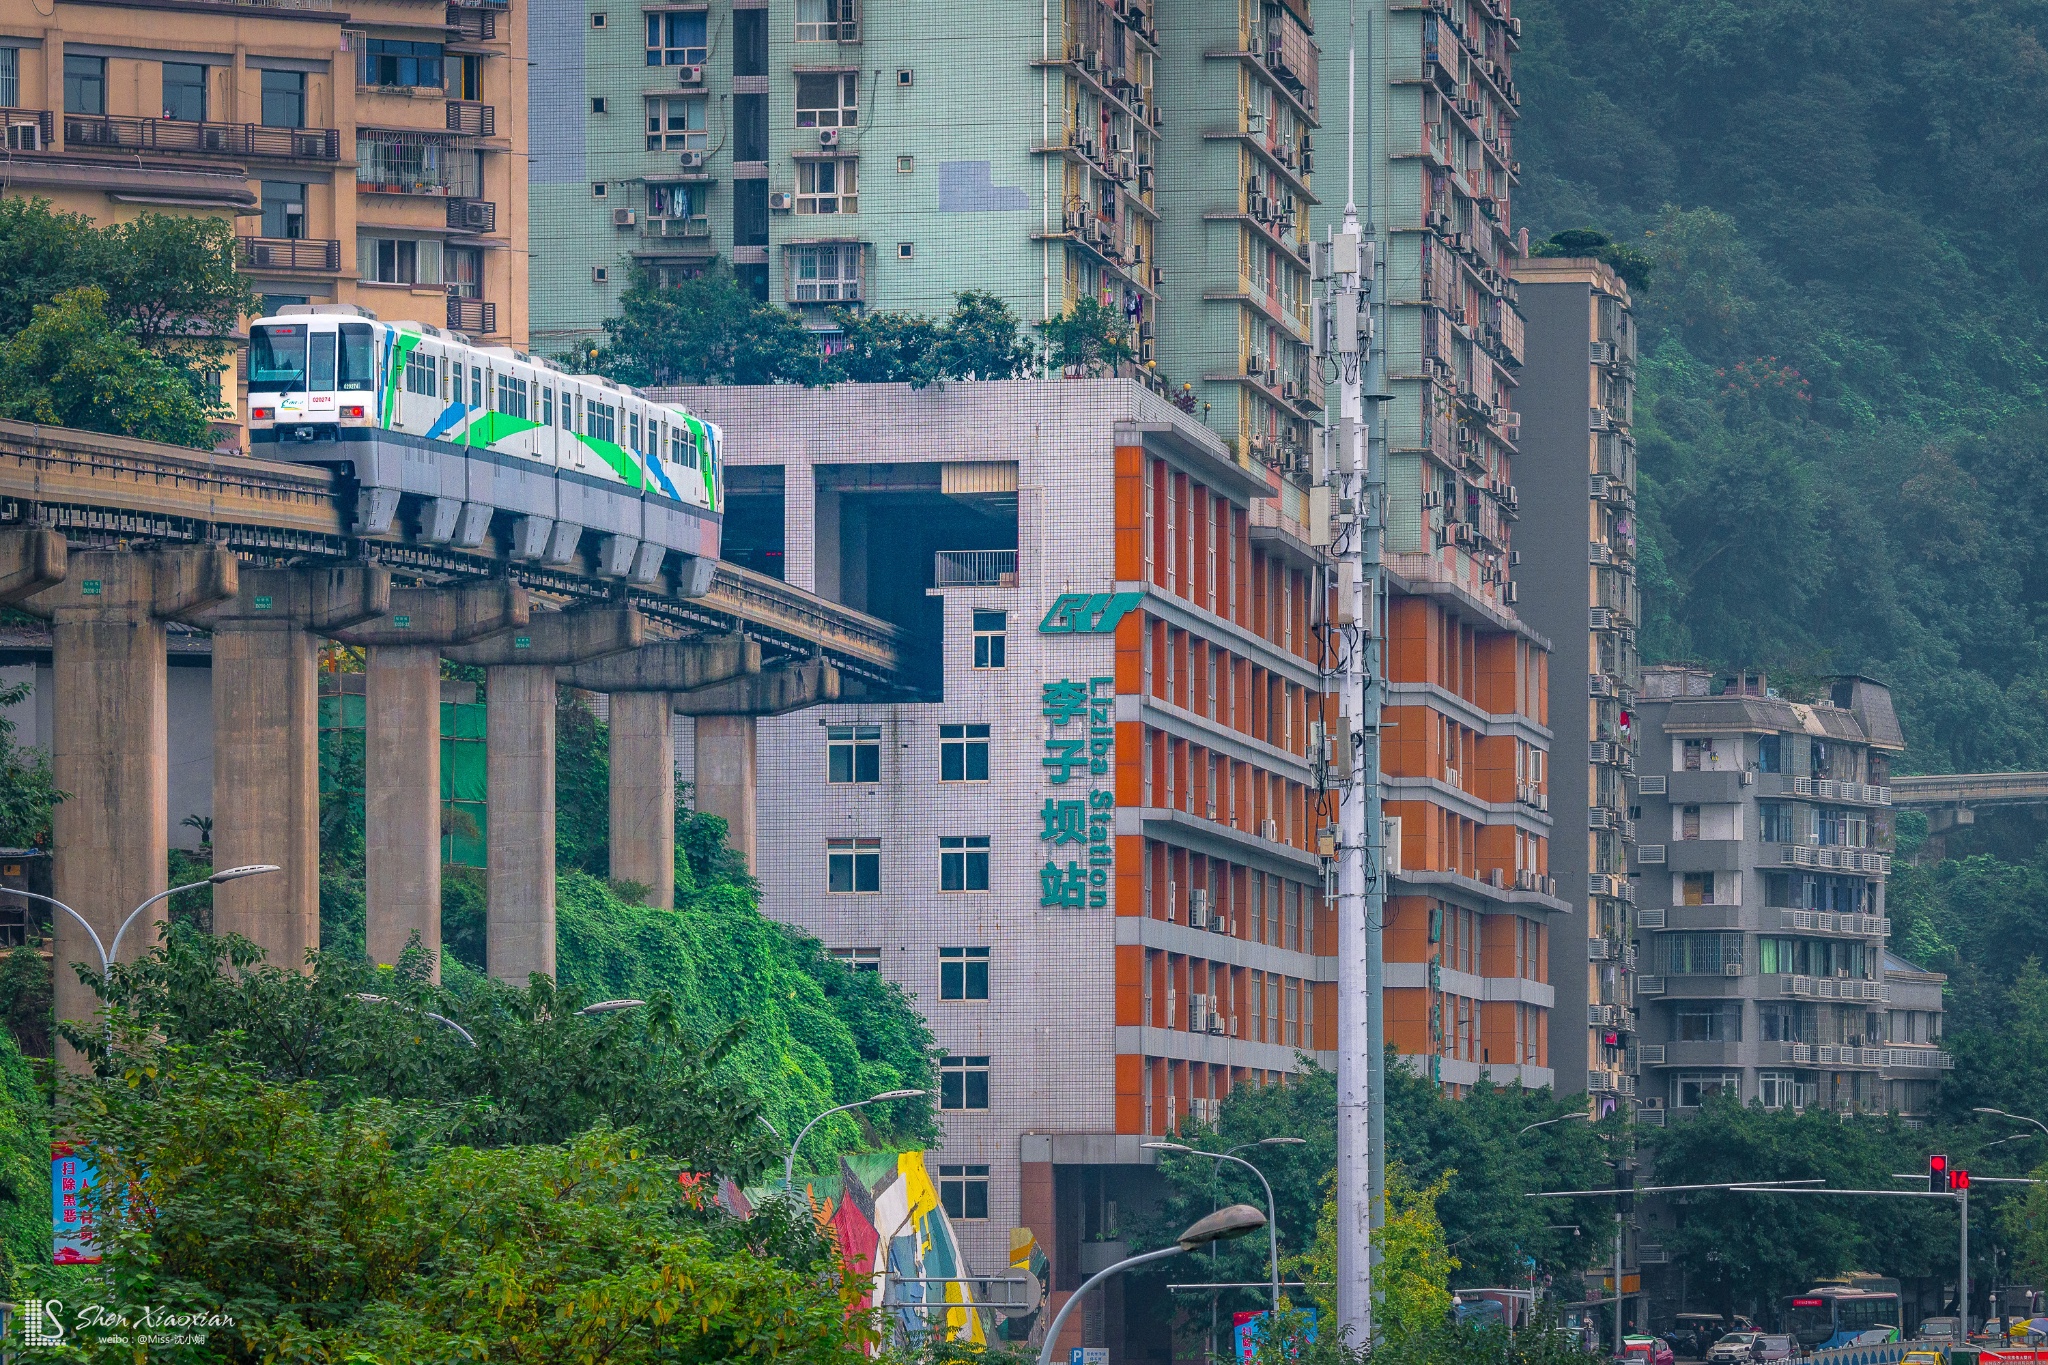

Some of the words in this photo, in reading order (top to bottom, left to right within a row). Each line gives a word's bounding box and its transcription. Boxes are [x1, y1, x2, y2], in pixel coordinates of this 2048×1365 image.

[1090, 676, 1114, 775] Liziba
[1040, 678, 1088, 909] 李子坝站
[1090, 788, 1113, 908] Station
[1949, 1170, 1970, 1189] 16
